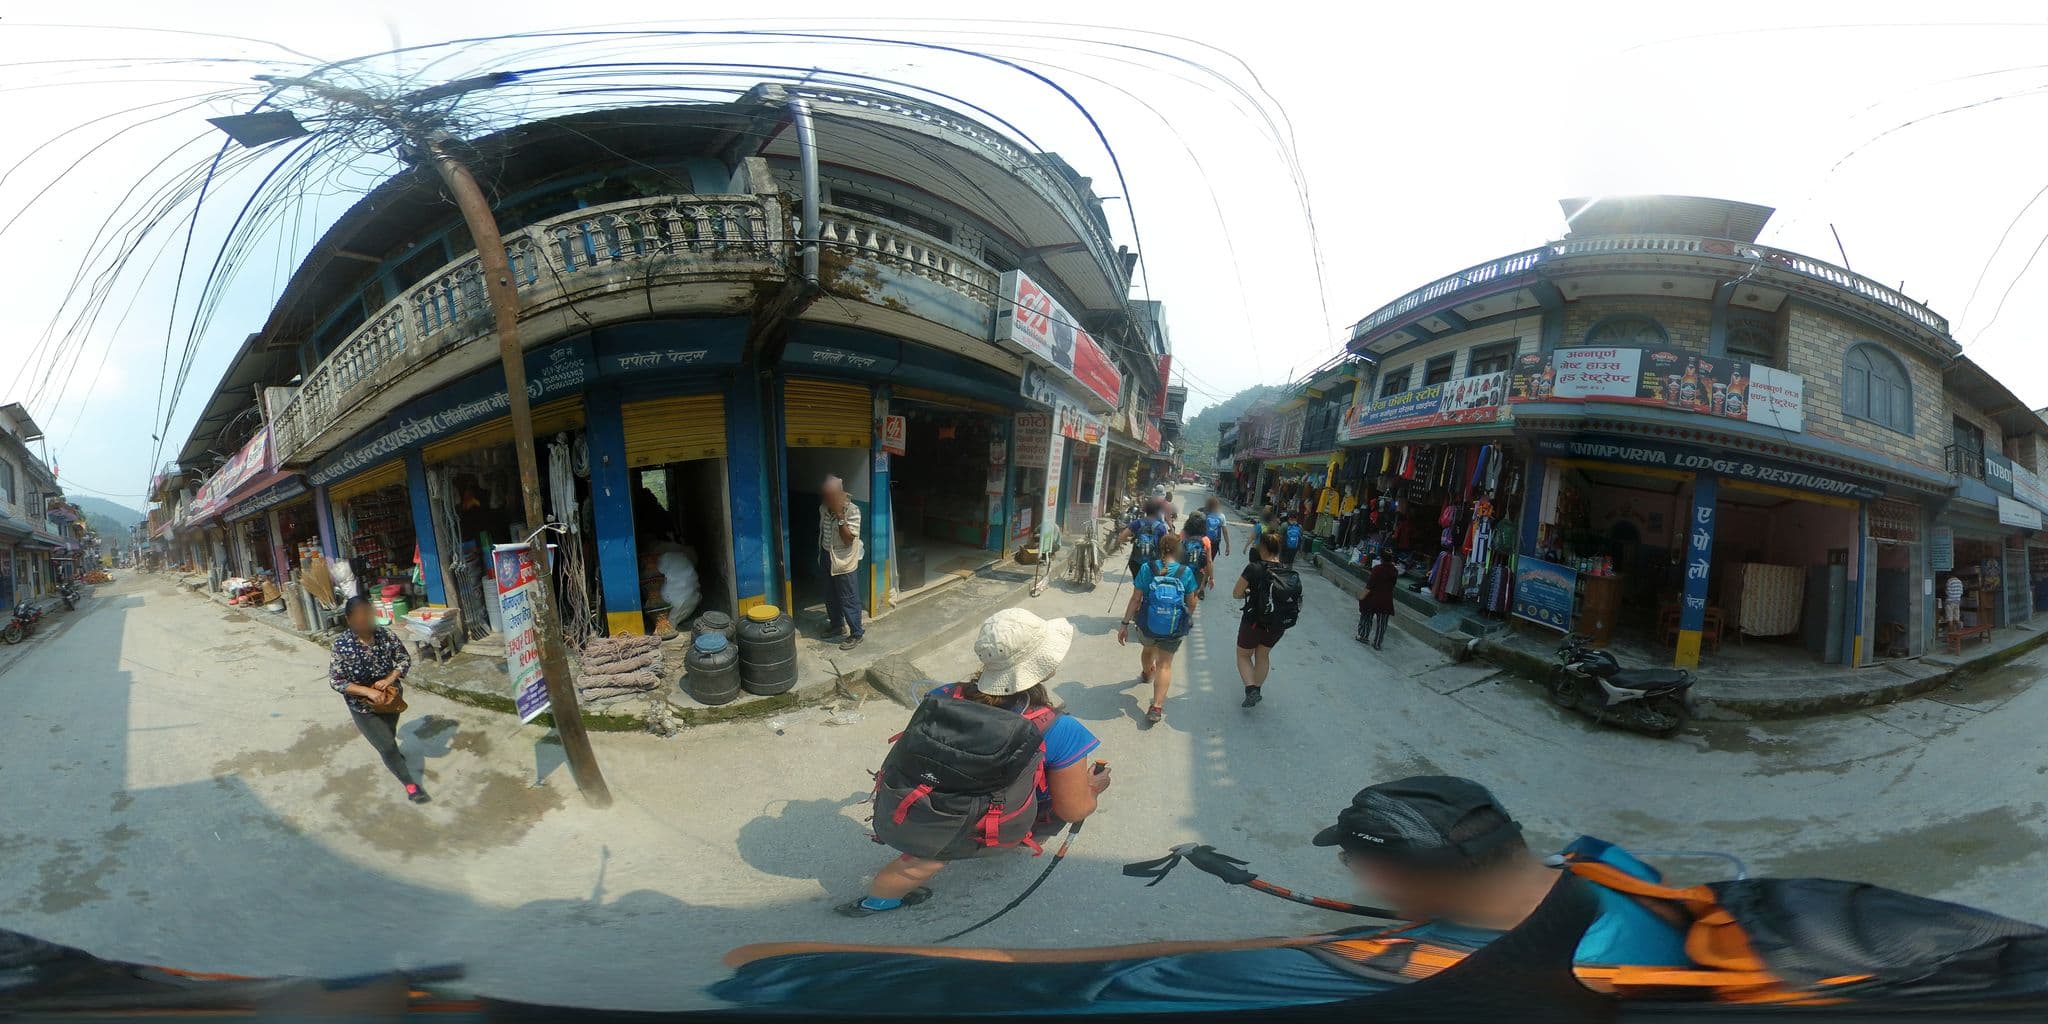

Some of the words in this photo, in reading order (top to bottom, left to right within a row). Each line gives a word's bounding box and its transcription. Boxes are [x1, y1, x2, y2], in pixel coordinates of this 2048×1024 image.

[1570, 441, 1667, 465] ANNAPURNA
[1673, 453, 1739, 475] LODGE
[1740, 463, 1756, 478] &
[1756, 466, 1858, 496] RESTAURANT
